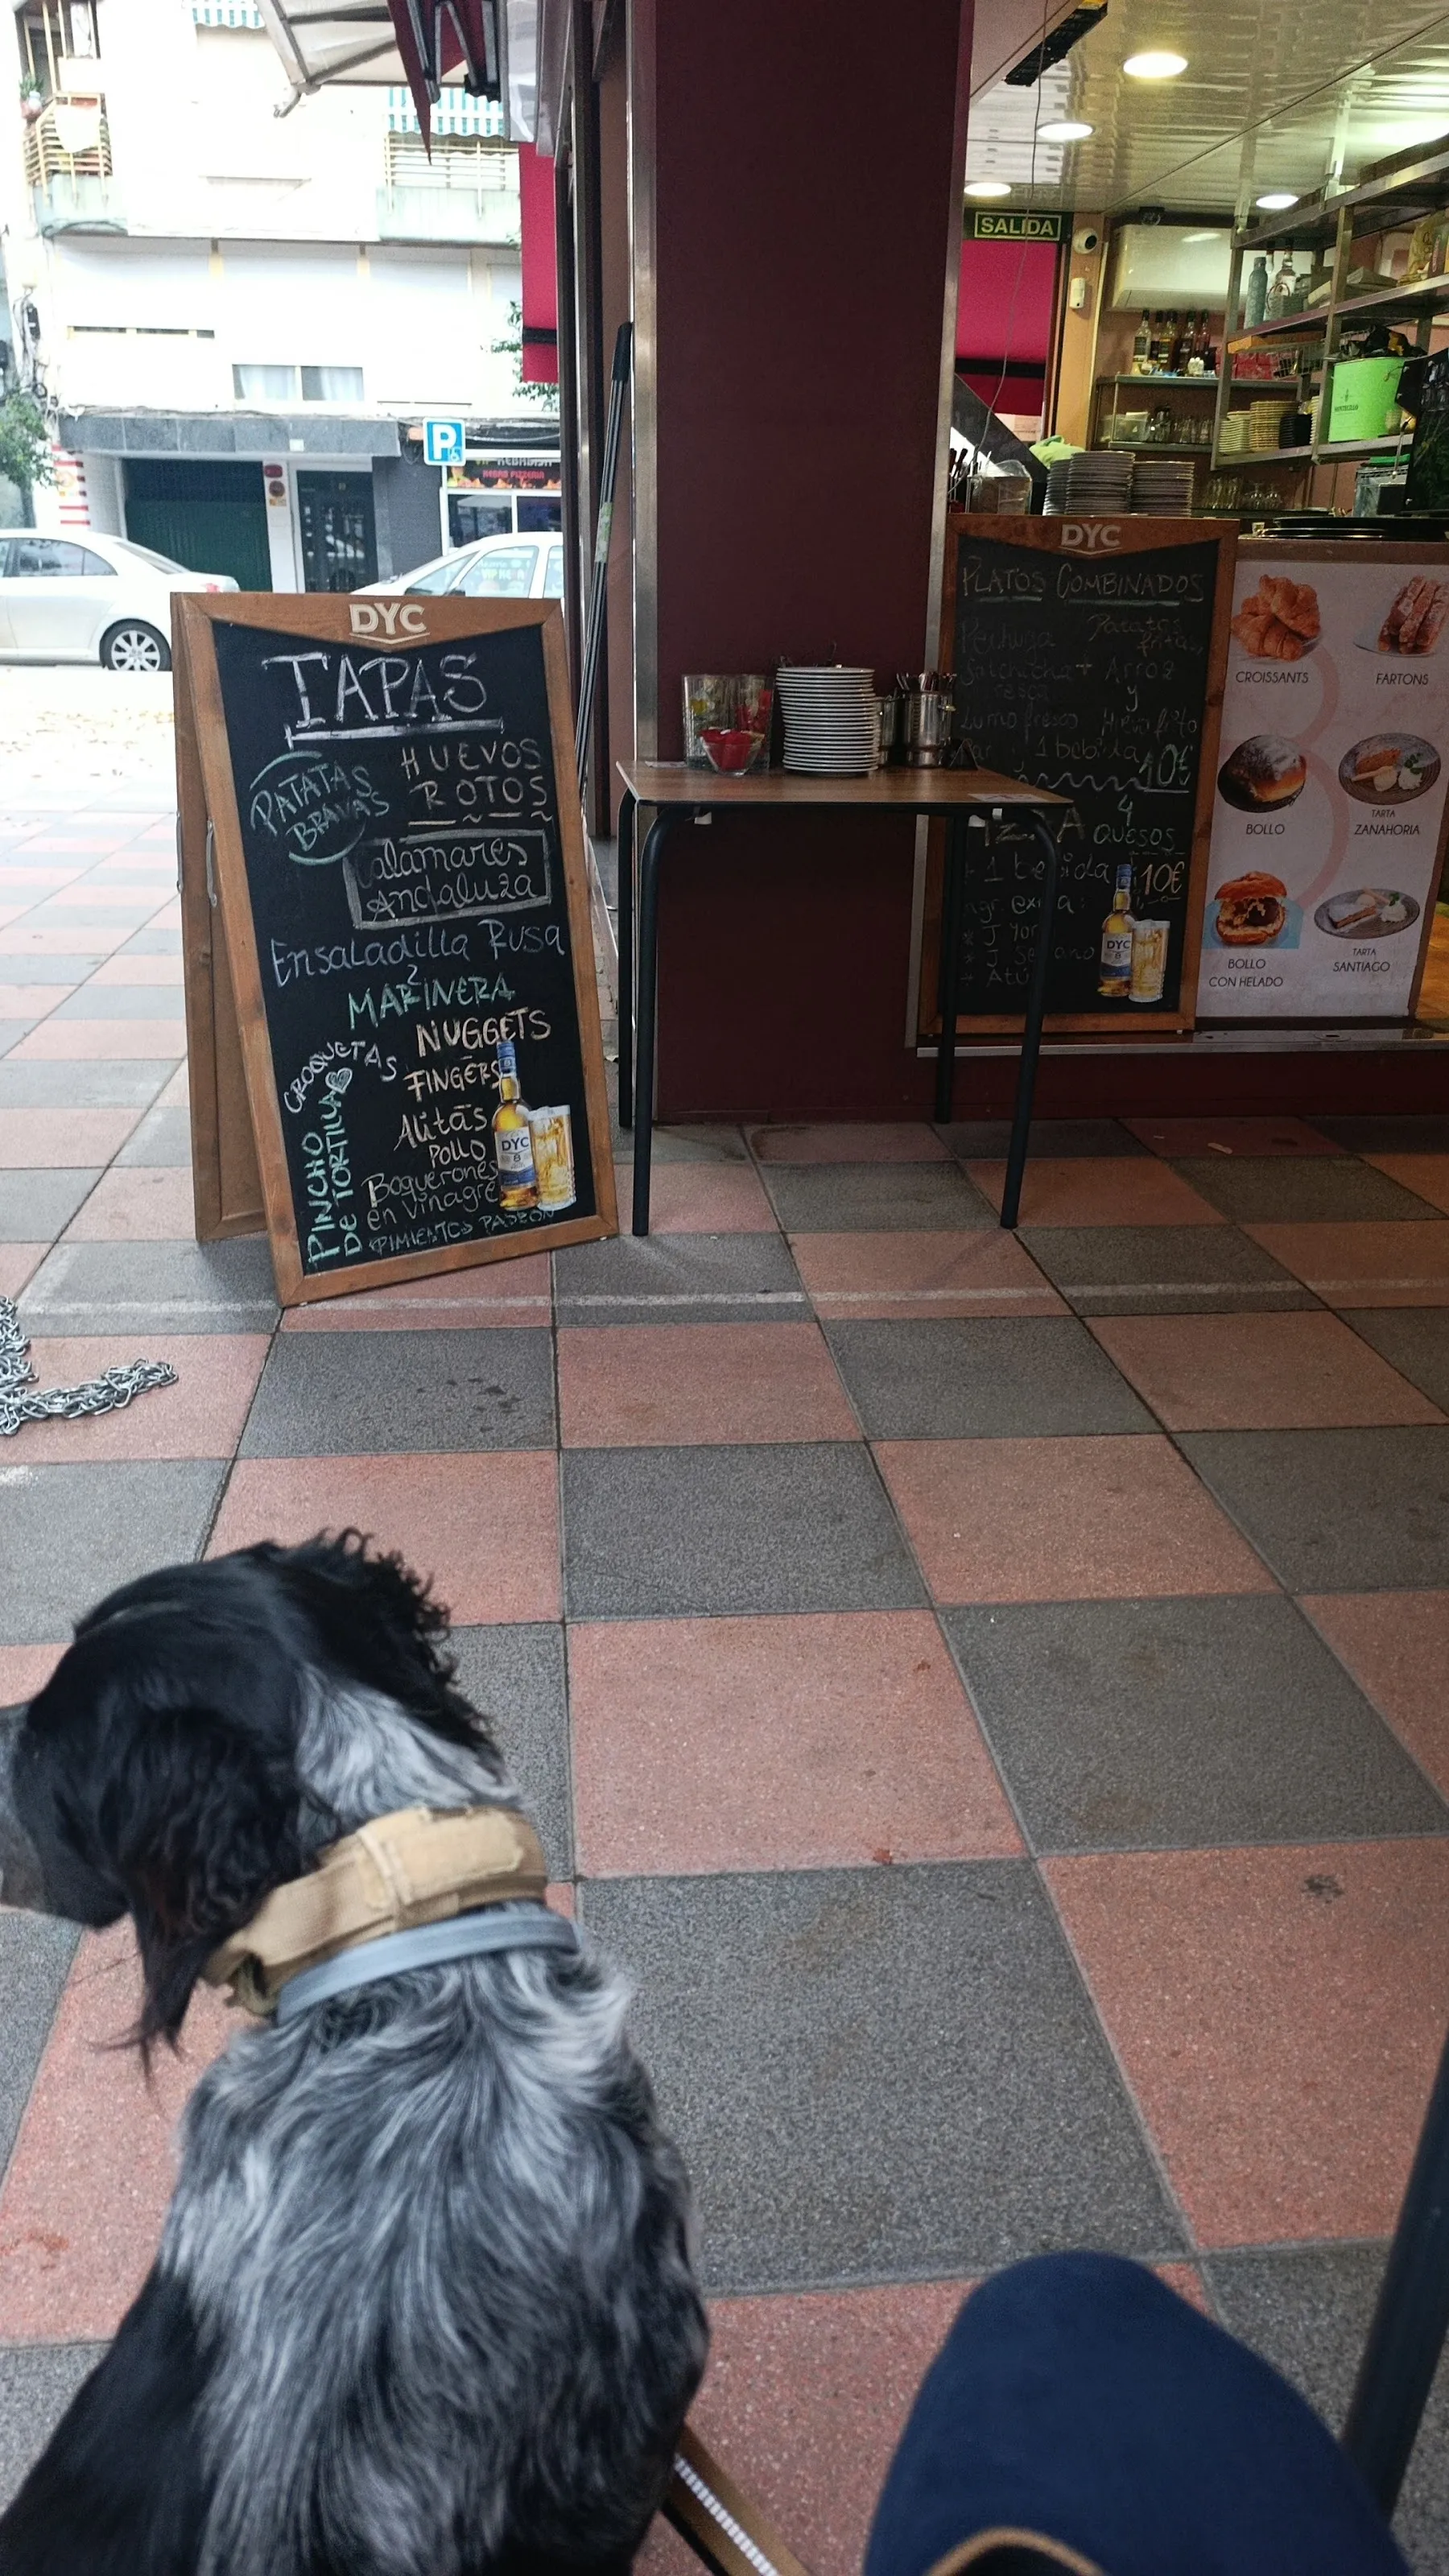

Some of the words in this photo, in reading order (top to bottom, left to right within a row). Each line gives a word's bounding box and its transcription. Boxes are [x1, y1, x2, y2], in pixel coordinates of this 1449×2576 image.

[980, 217, 1054, 236] SALIDA
[431, 423, 457, 460] P
[1061, 523, 1122, 547] DYC
[963, 556, 1045, 597] PLATOS
[1055, 563, 1204, 601] COMBINADOS
[349, 602, 428, 636] DYC
[1104, 655, 1177, 683] Arroz
[1236, 671, 1310, 684] CROISSANTS
[1375, 673, 1430, 686] FARTONS
[262, 652, 487, 729] TAPAS
[1125, 684, 1139, 712] y
[401, 737, 544, 781] HUEVOS
[1034, 735, 1049, 758] 1
[250, 759, 373, 838] PATATAS
[409, 774, 548, 810] ROTOS
[285, 791, 390, 852] BRAVAS
[1117, 794, 1133, 828] 4
[1371, 809, 1396, 818] TARTA
[1093, 824, 1177, 851] QUESOS
[1245, 824, 1286, 836] BOLLO
[1354, 824, 1420, 836] ZANAHORIA
[1014, 851, 1112, 886] beida
[1140, 861, 1186, 896] 10€
[365, 871, 538, 923] Andaluza
[962, 897, 1005, 923] ngr.
[1010, 894, 1087, 915] exa:
[981, 924, 1001, 947] J
[1009, 922, 1041, 943] Yor
[1107, 939, 1132, 950] DYC
[270, 927, 471, 988] Ensaladilla
[477, 919, 566, 960] Rusa
[985, 949, 999, 968] J
[1013, 945, 1096, 966] Seano
[1228, 959, 1266, 969] BOLLO
[1333, 961, 1391, 972] SANTIAGO
[1352, 948, 1377, 956] TARTA
[985, 968, 1030, 988] Atú
[1209, 976, 1236, 988] CON
[1239, 976, 1284, 988] HELADO
[348, 972, 516, 1031] MARINERA
[415, 1006, 552, 1058] NUGGETS
[284, 1041, 398, 1114] CROQUETAS
[402, 1059, 501, 1103] FINGERS
[393, 1106, 488, 1152] Alitas
[501, 1136, 530, 1152] DYC
[318, 1090, 354, 1207] TORTILLA
[513, 1154, 522, 1162] 8
[301, 1132, 341, 1267] PINCHO
[361, 1160, 499, 1208] Boquerones
[366, 1207, 397, 1231] en
[402, 1180, 499, 1215] vinagre
